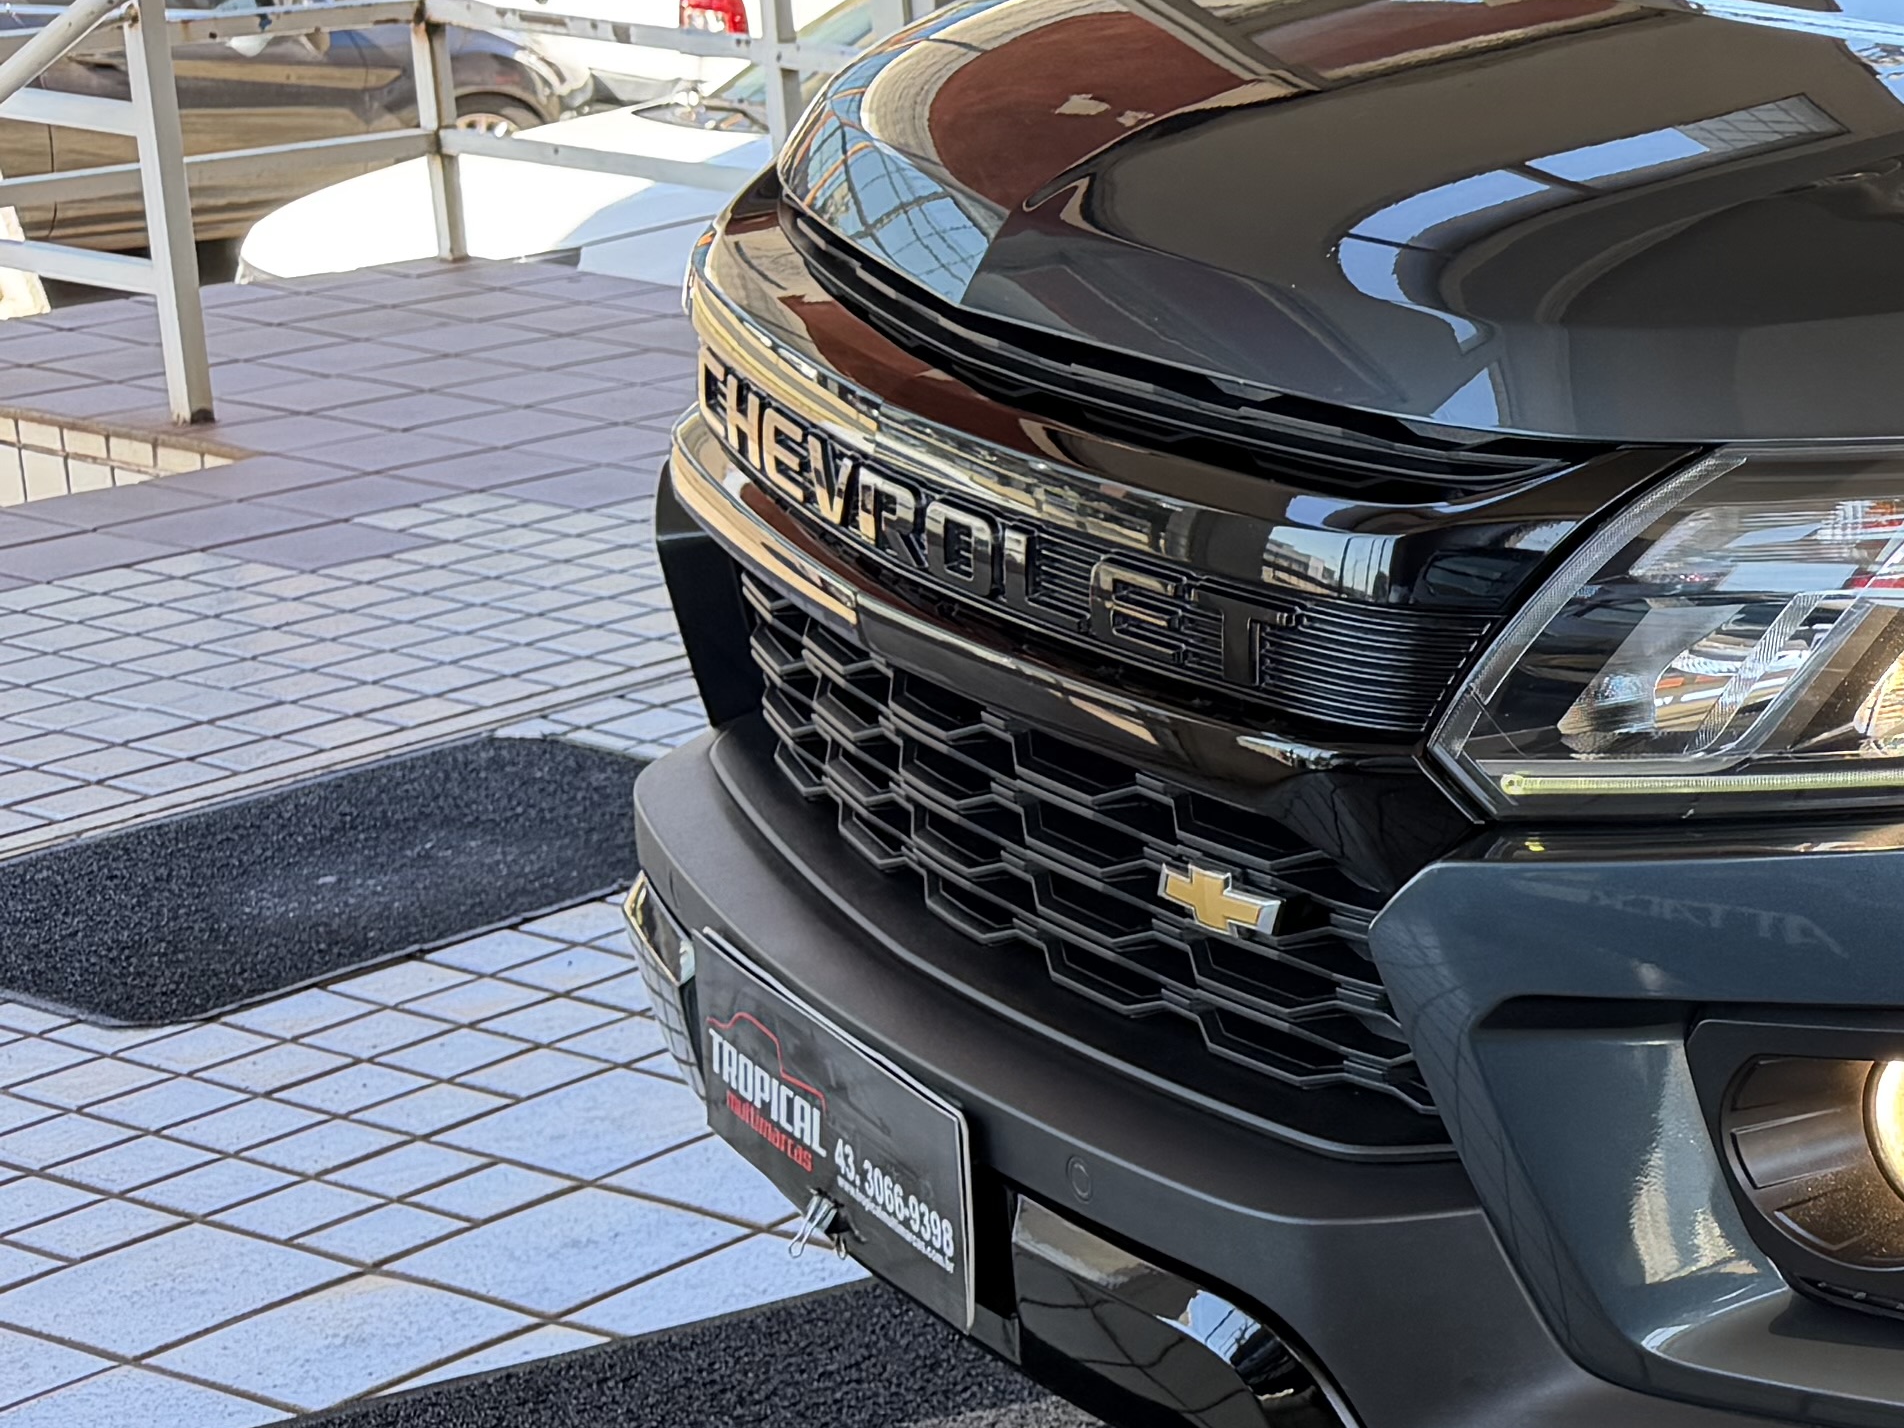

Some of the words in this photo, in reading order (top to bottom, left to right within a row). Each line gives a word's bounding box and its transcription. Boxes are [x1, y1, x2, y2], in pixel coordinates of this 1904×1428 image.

[700, 356, 1302, 689] CHEVROLET
[708, 1028, 828, 1158] TROPICAL
[726, 1089, 815, 1173] multimarcas
[863, 1159, 955, 1258] 3066-9398
